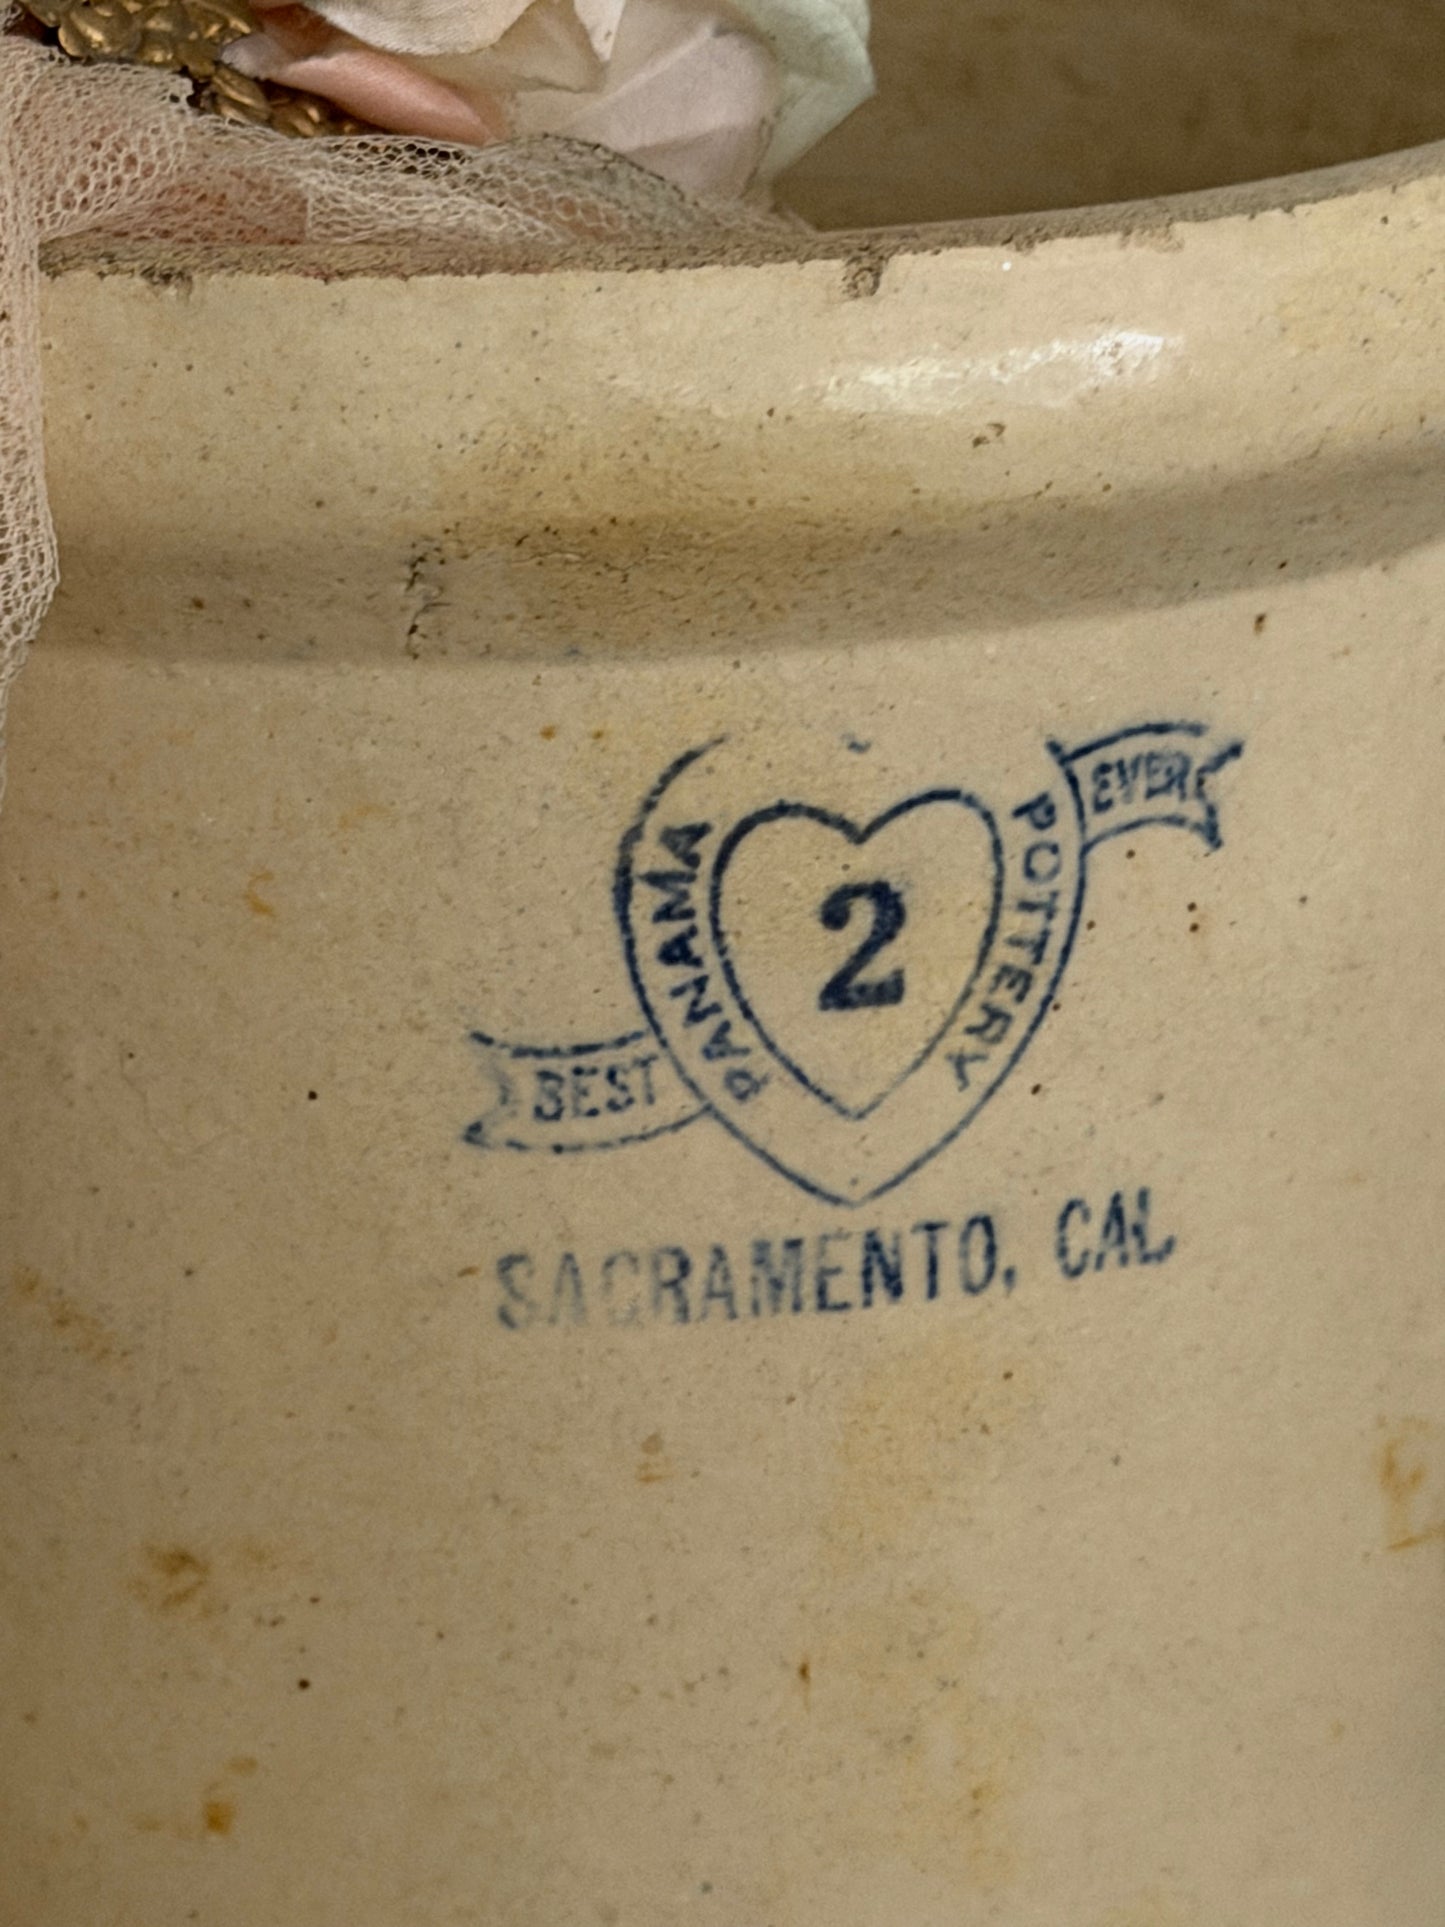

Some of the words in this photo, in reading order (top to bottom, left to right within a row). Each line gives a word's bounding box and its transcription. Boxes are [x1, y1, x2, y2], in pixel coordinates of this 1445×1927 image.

[1091, 750, 1193, 814] EVER
[638, 821, 772, 1101] PANAMA
[944, 791, 1061, 1092] POTTERY
[818, 880, 907, 1012] 2
[533, 1054, 658, 1122] BEST
